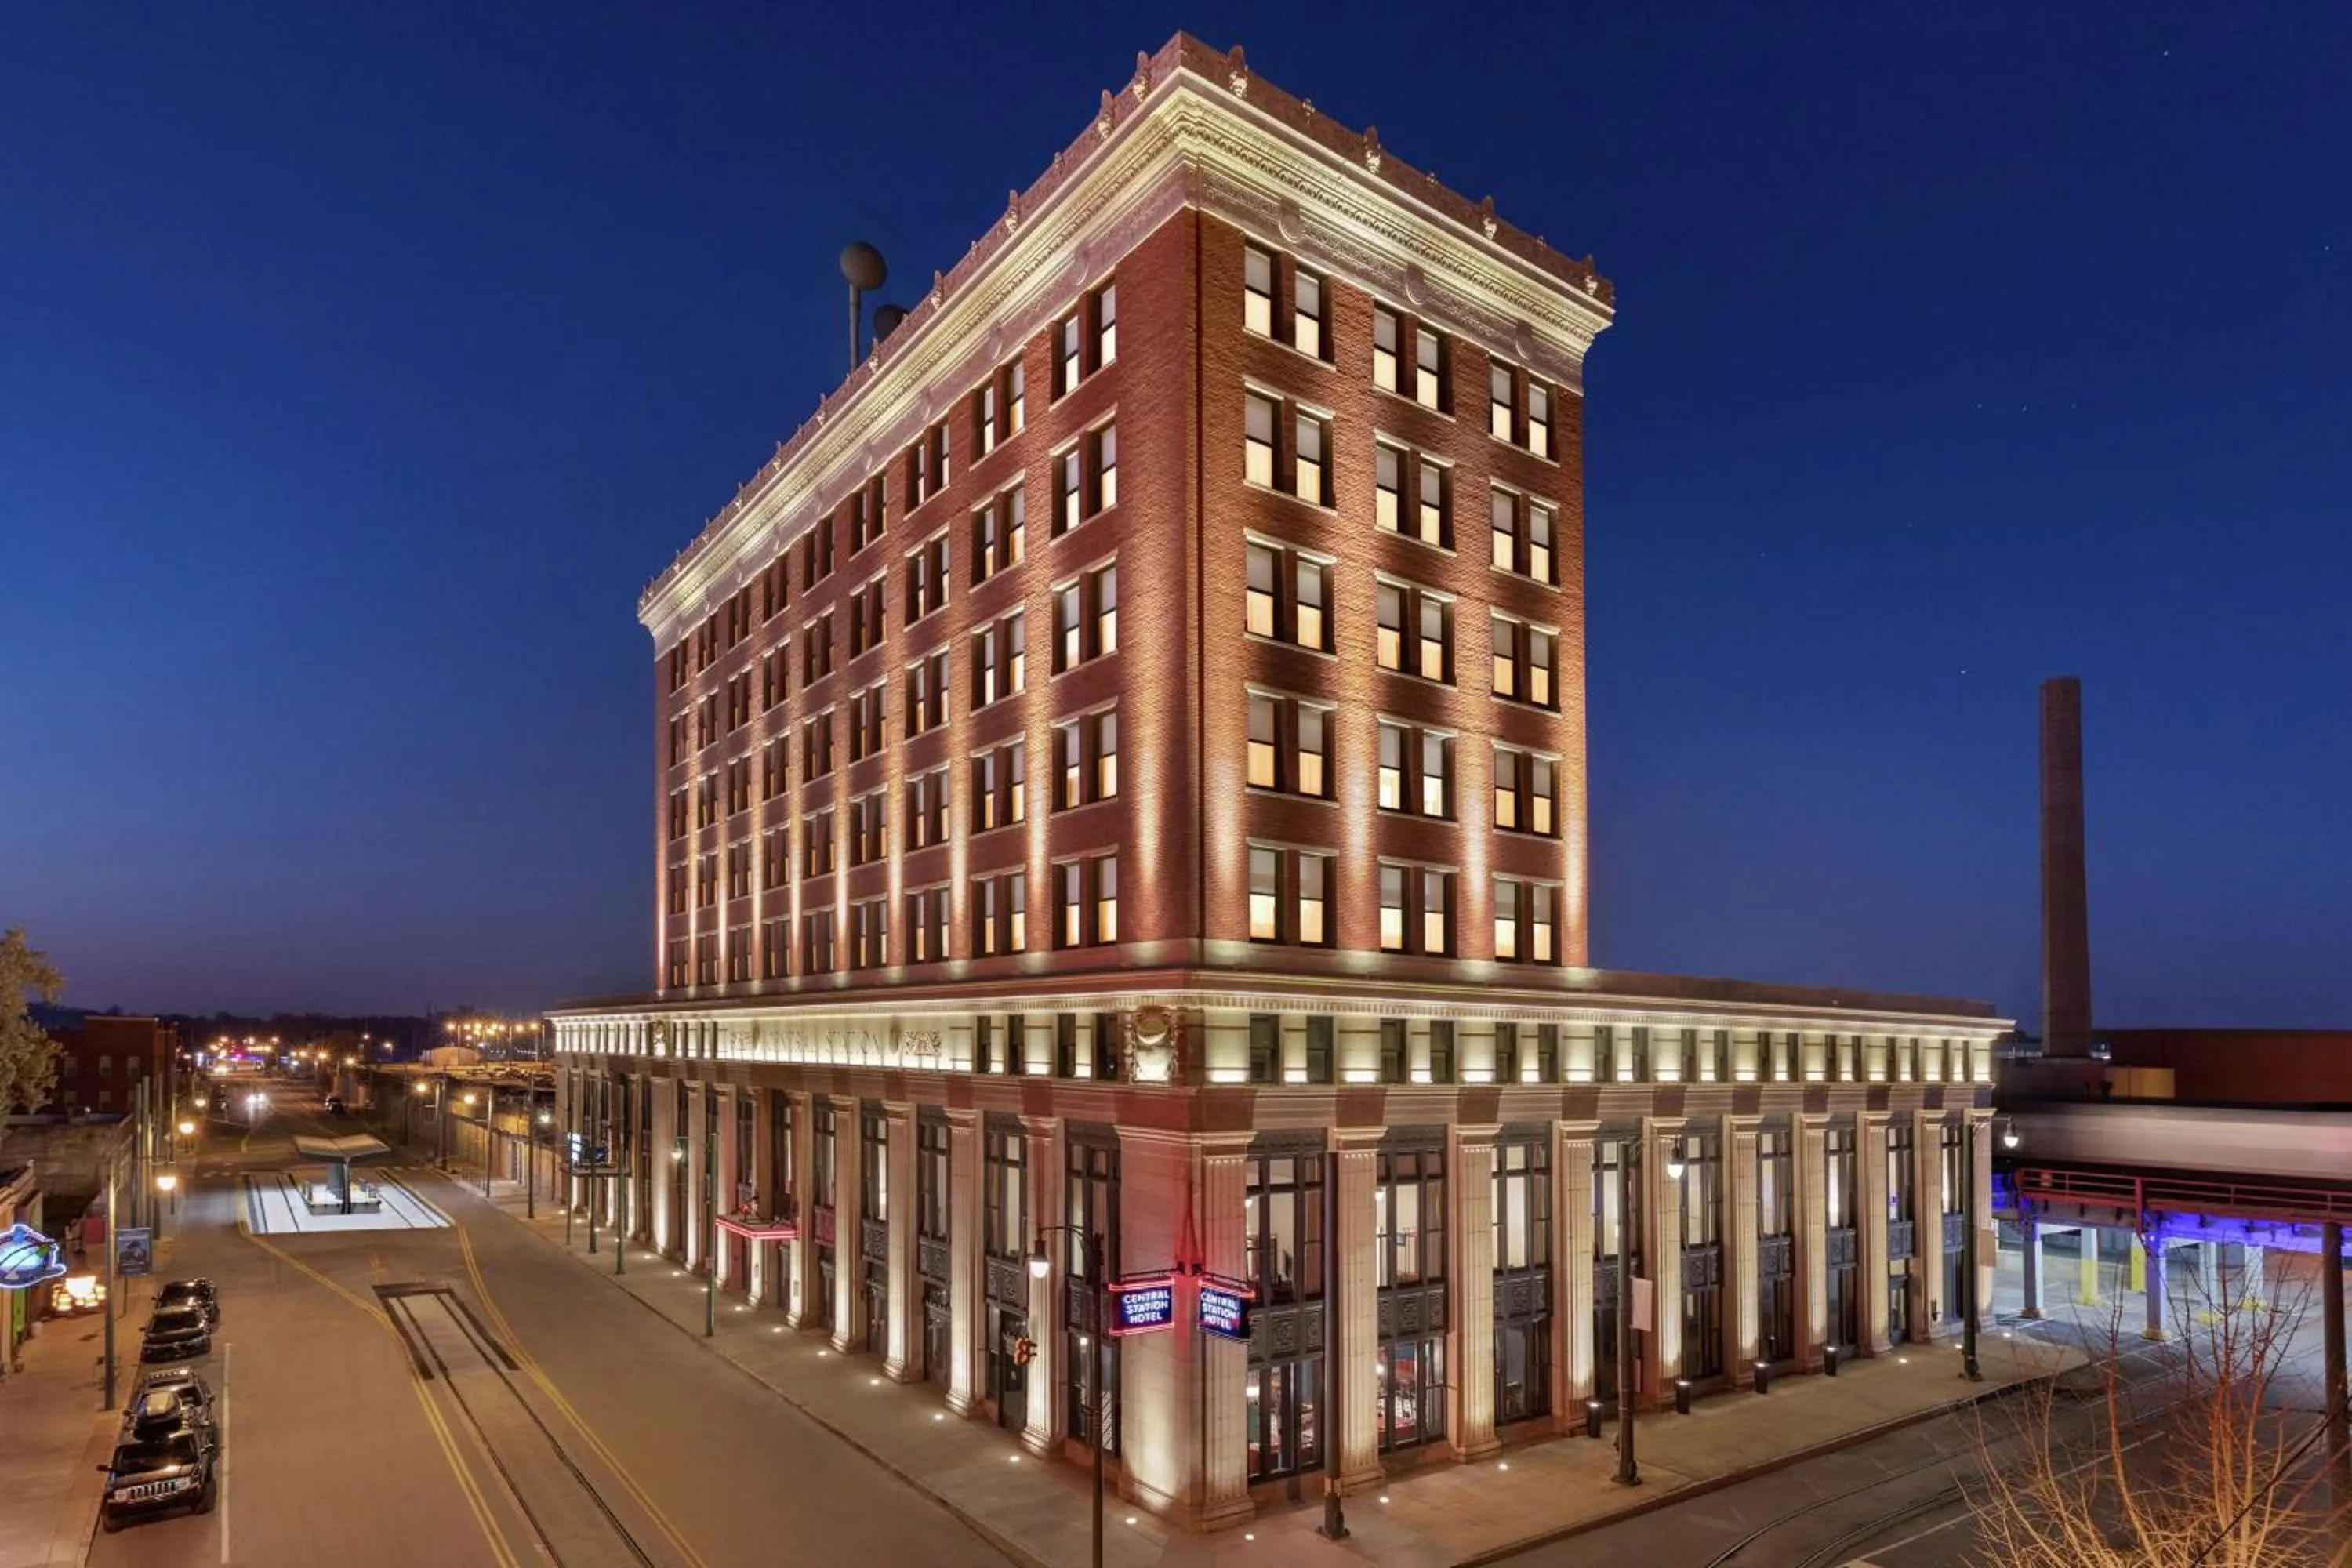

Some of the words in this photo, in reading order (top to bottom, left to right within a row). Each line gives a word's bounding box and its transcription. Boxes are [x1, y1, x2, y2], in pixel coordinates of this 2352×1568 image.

[1123, 1290, 1170, 1304] CENTRAL
[1200, 1292, 1238, 1310] CENTRAL
[1126, 1301, 1168, 1314] STATION
[1202, 1303, 1238, 1318] STATION
[1130, 1312, 1162, 1323] HOTEL
[1204, 1314, 1232, 1330] HOTEL
